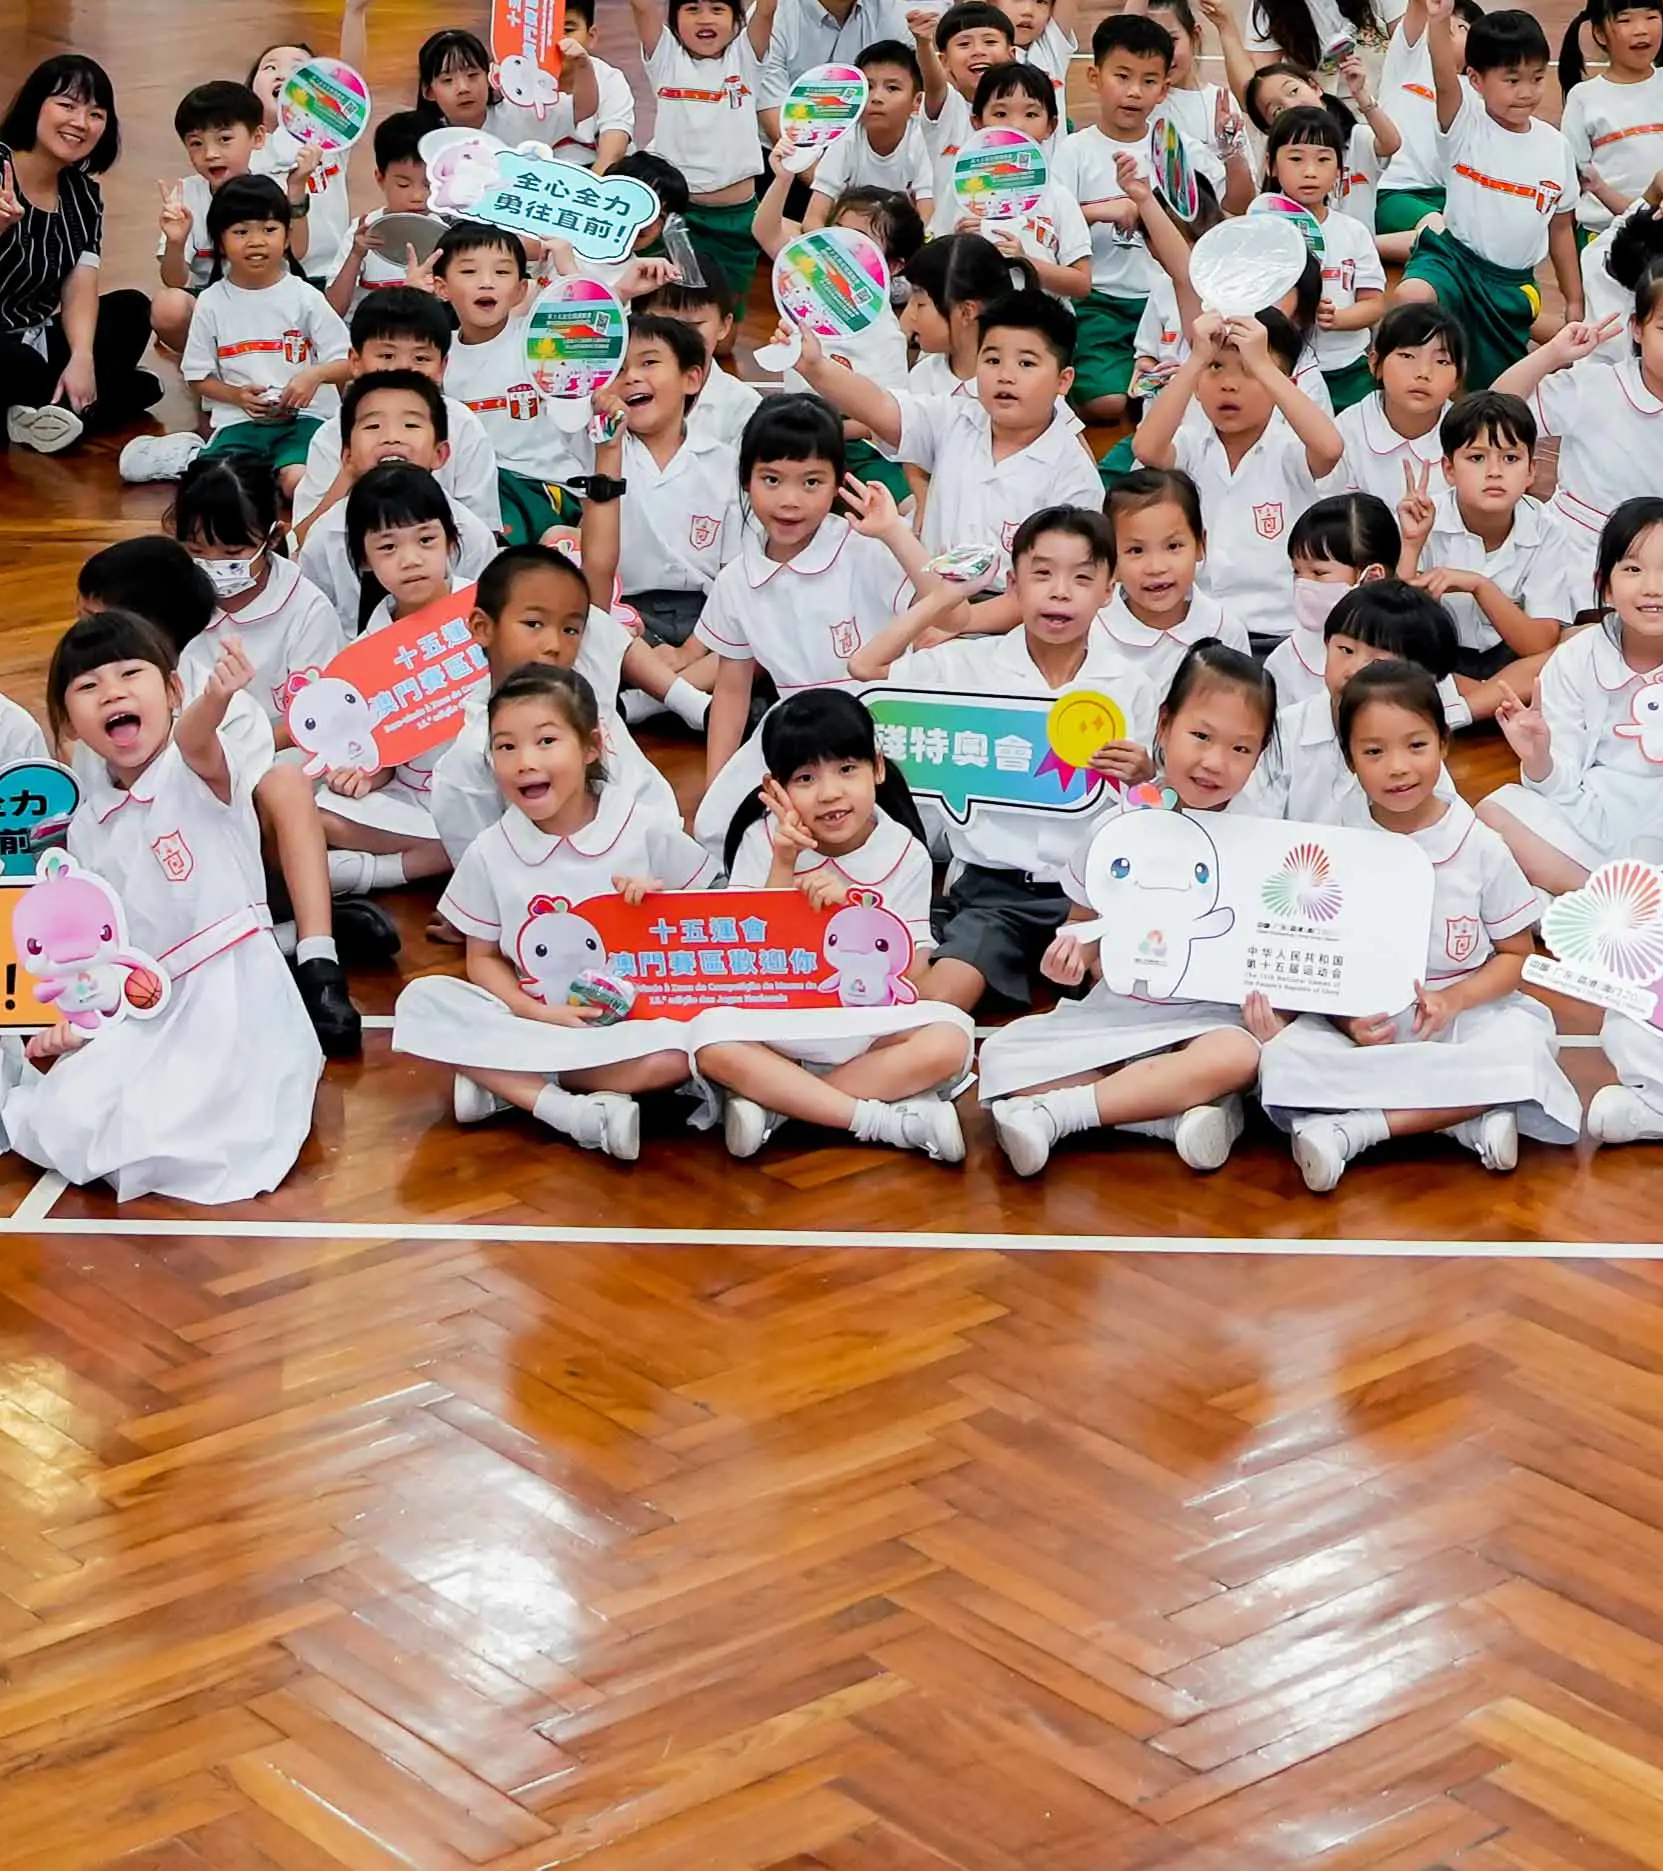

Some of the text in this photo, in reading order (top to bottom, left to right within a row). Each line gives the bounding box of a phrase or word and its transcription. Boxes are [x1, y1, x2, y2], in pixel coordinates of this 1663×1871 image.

[512, 171, 631, 217] 全心全力
[494, 192, 627, 243] 勇往直前!
[393, 617, 473, 670] 十五運
[648, 915, 768, 944] 十五運會
[1247, 946, 1344, 966] 中华人民共和国
